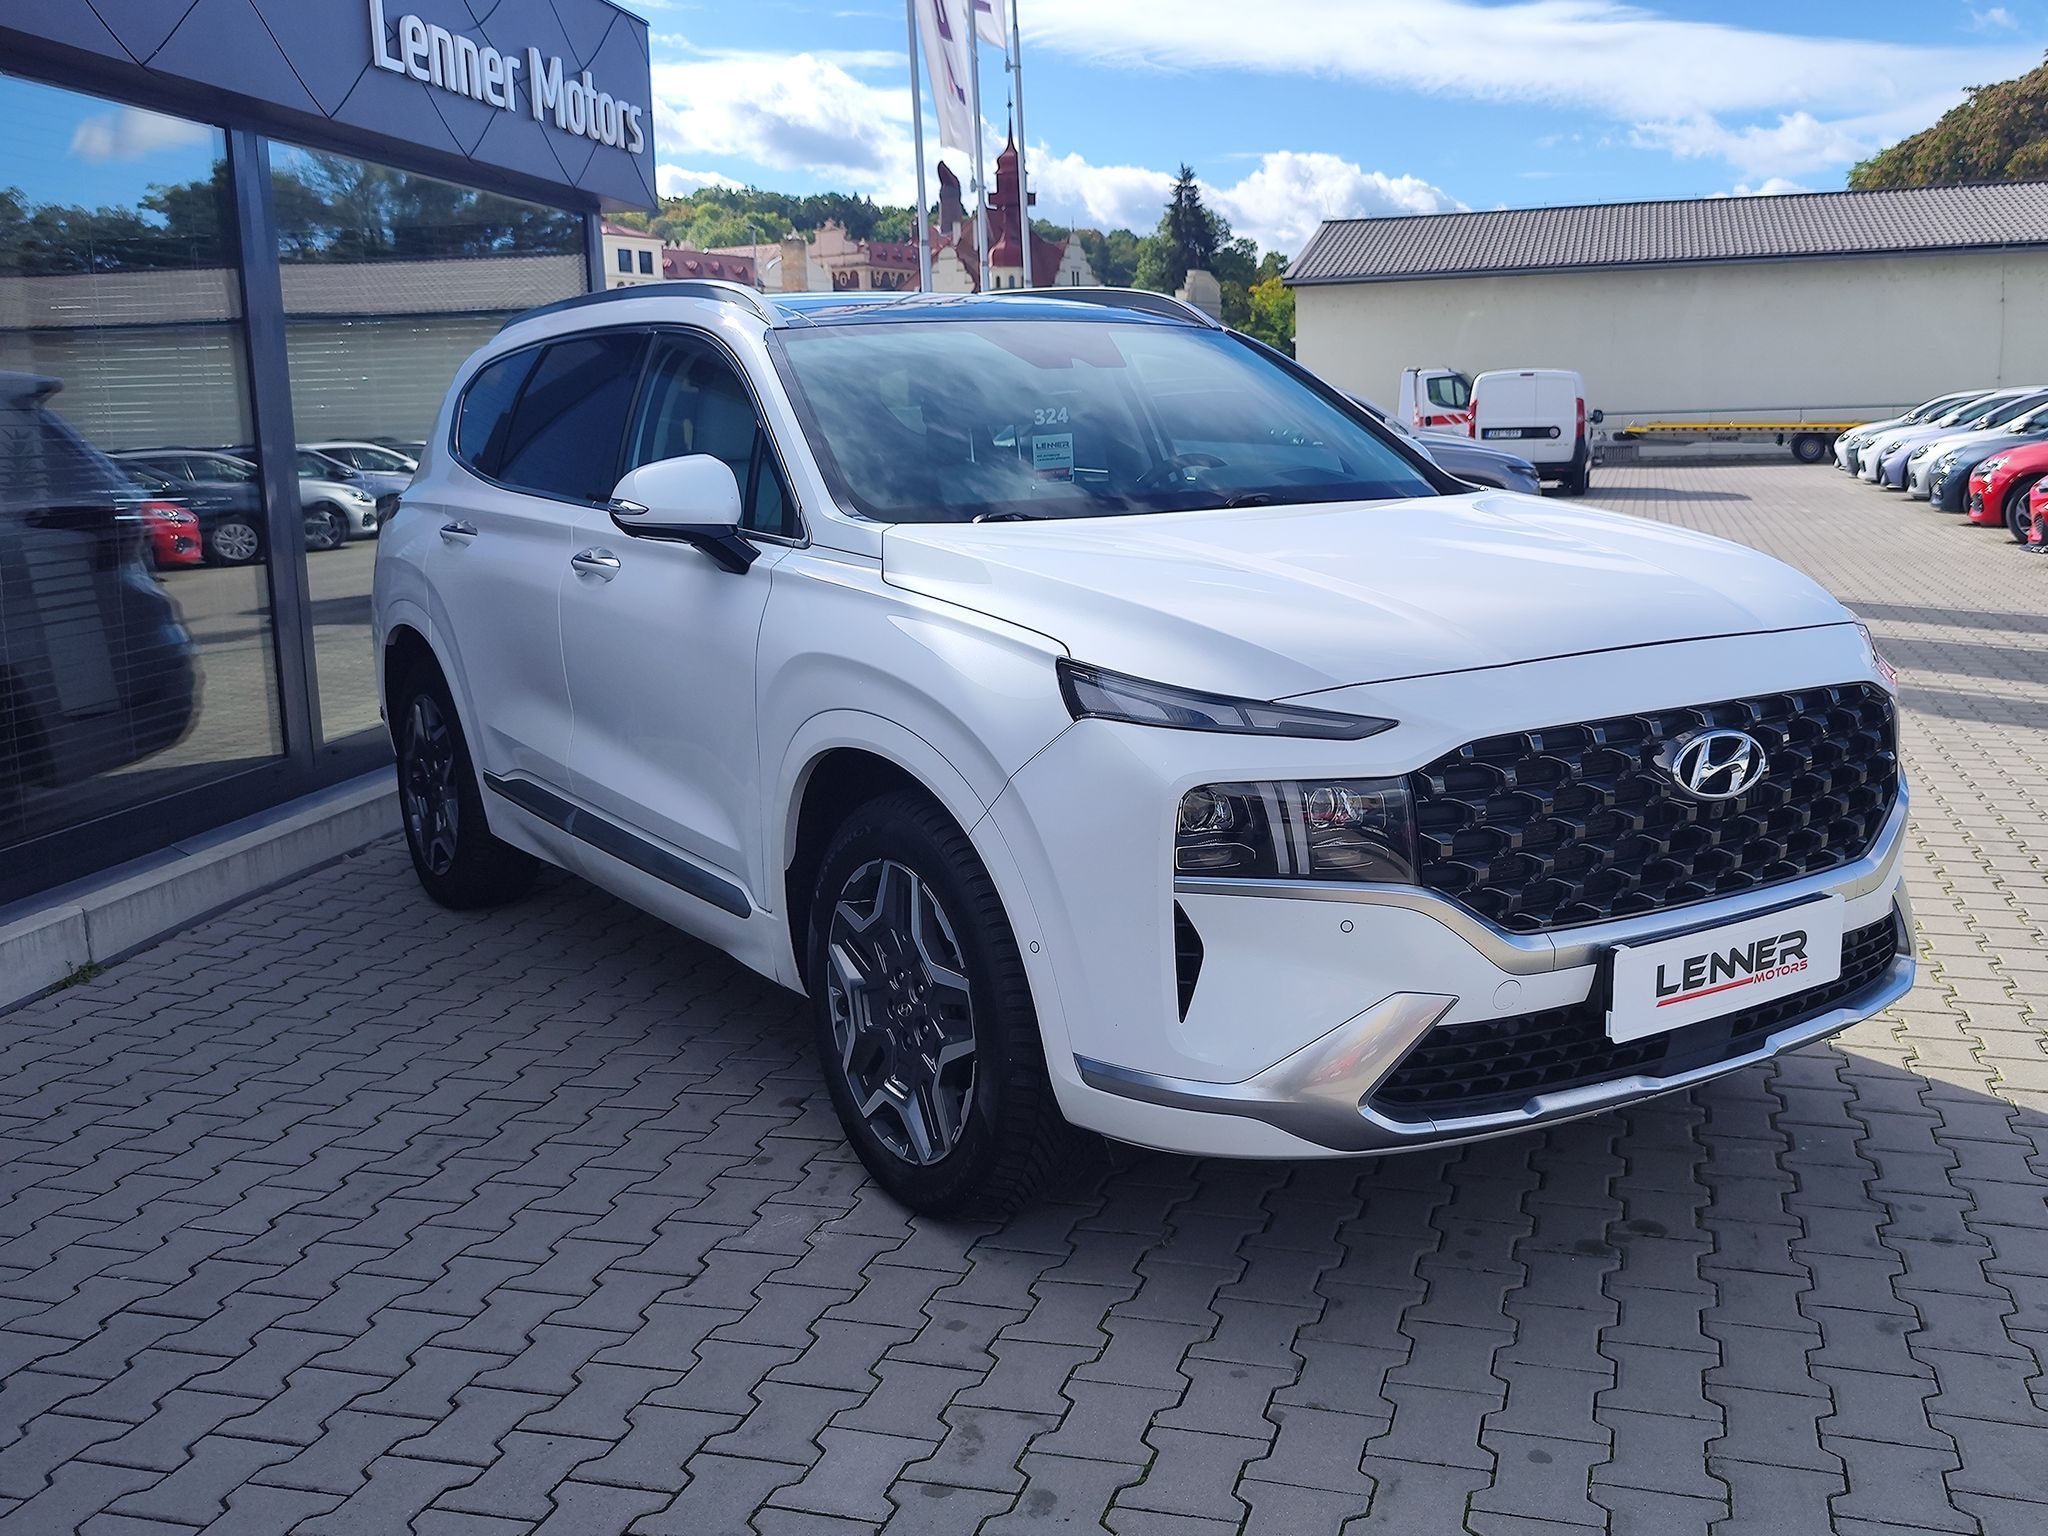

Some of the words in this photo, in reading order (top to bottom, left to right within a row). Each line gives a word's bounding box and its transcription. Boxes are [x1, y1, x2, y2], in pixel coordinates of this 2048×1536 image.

[368, 0, 521, 112] Lenner
[528, 46, 645, 155] Motors
[1034, 407, 1069, 425] 324
[1656, 929, 1808, 998] LENNER
[1753, 959, 1808, 985] MOTORS
